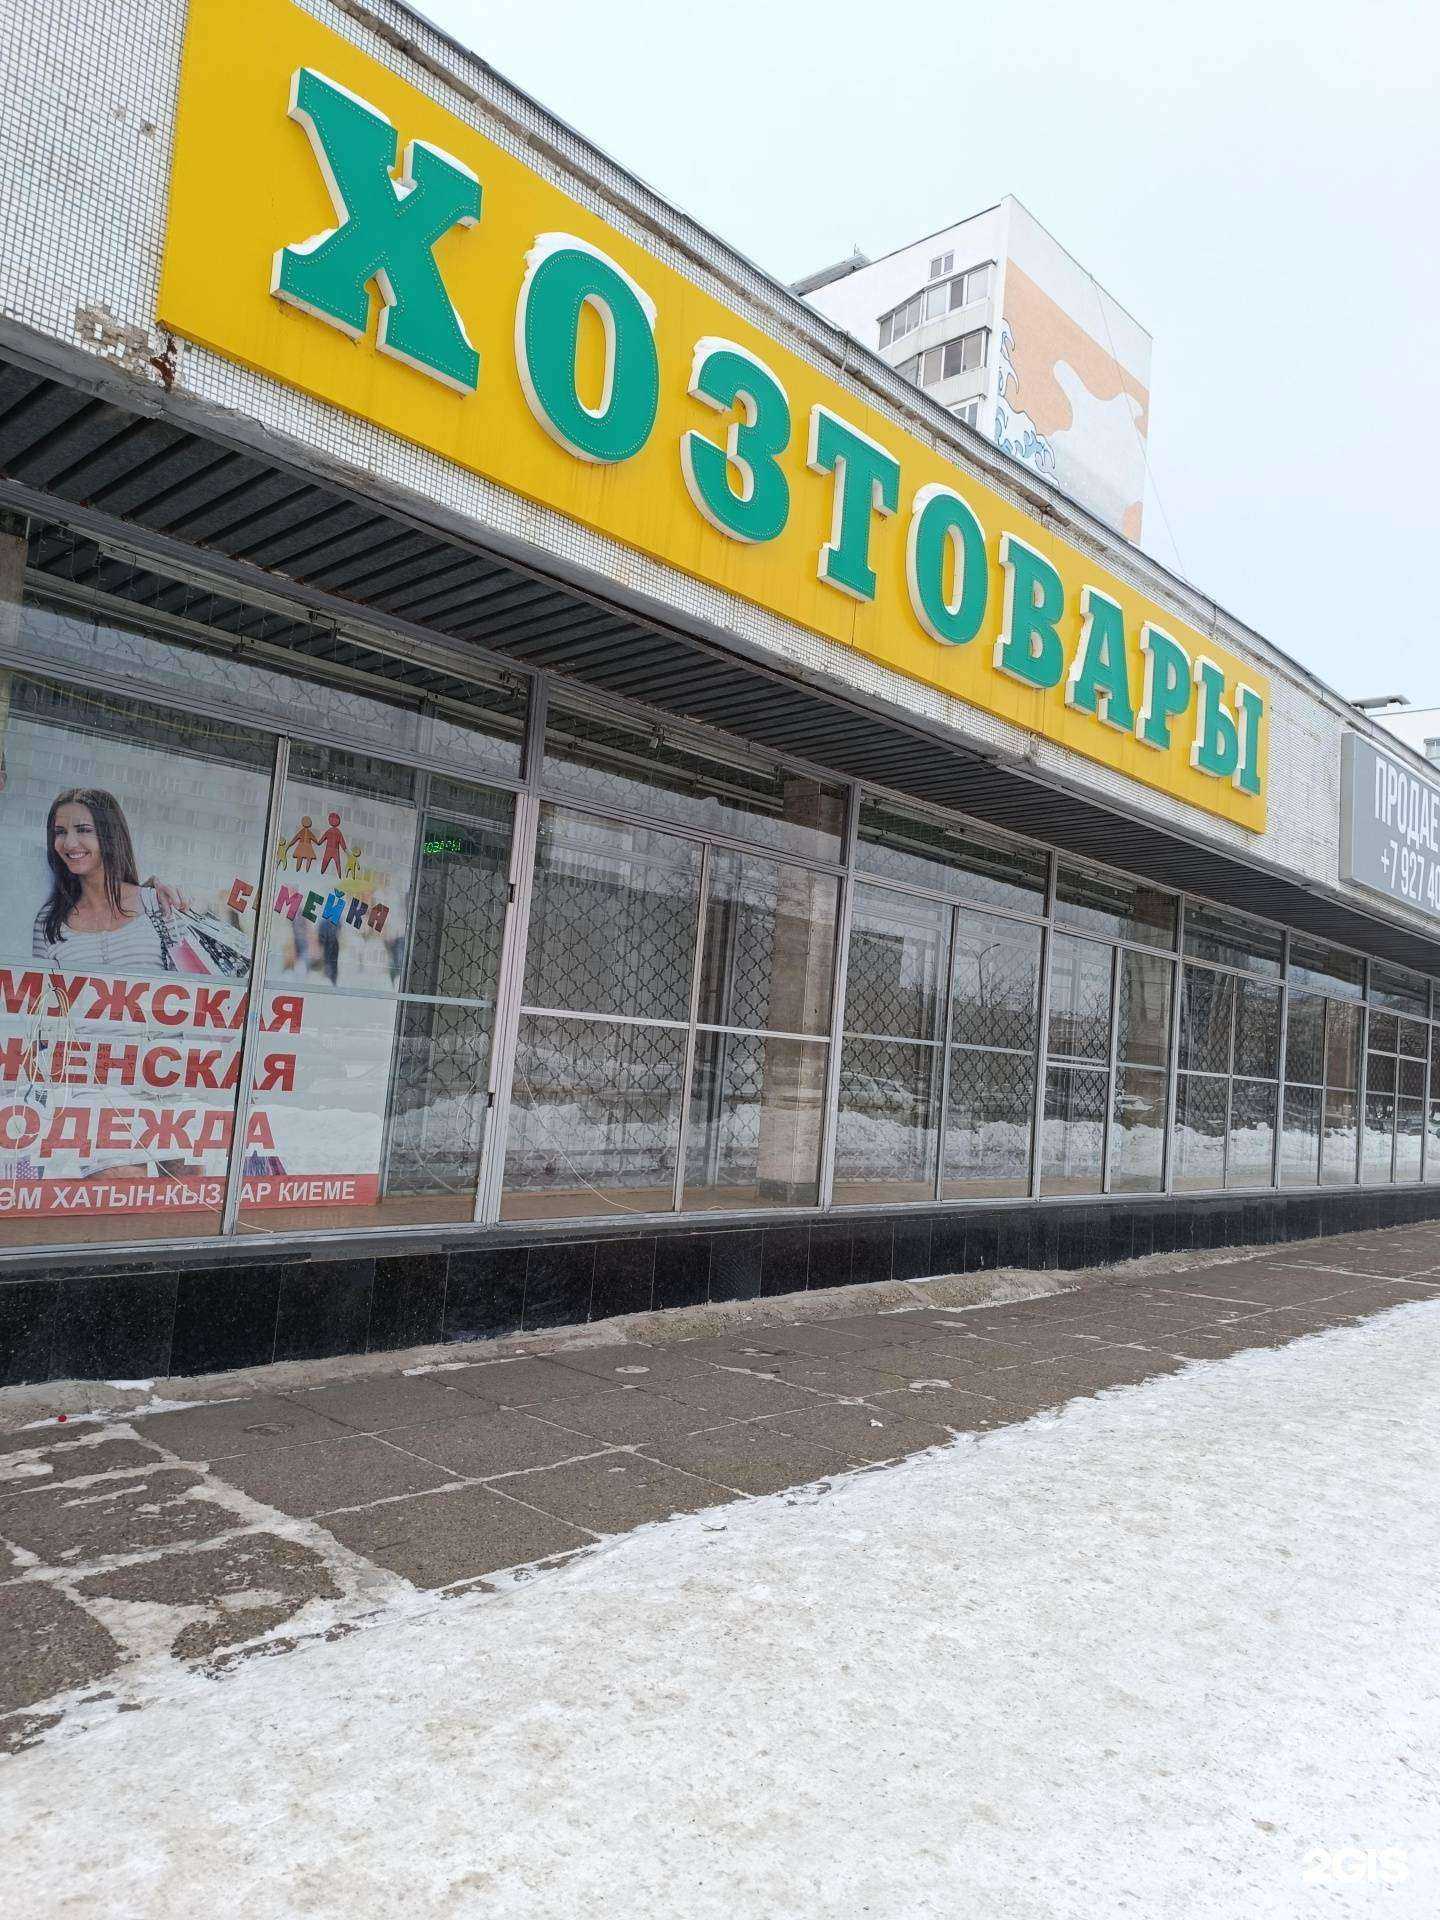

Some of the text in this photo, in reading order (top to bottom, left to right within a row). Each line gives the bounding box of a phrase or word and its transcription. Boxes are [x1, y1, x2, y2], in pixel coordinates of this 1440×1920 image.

[270, 67, 1264, 797] ХОЗТОВАРЫ
[1401, 846, 1425, 902] 927
[227, 878, 390, 933] СМЕЙКА
[0, 1105, 276, 1159] ОДЕЖДА
[50, 1182, 272, 1209] ХАТЫН-КЫЗАР
[279, 1180, 356, 1202] КИЕМЕ
